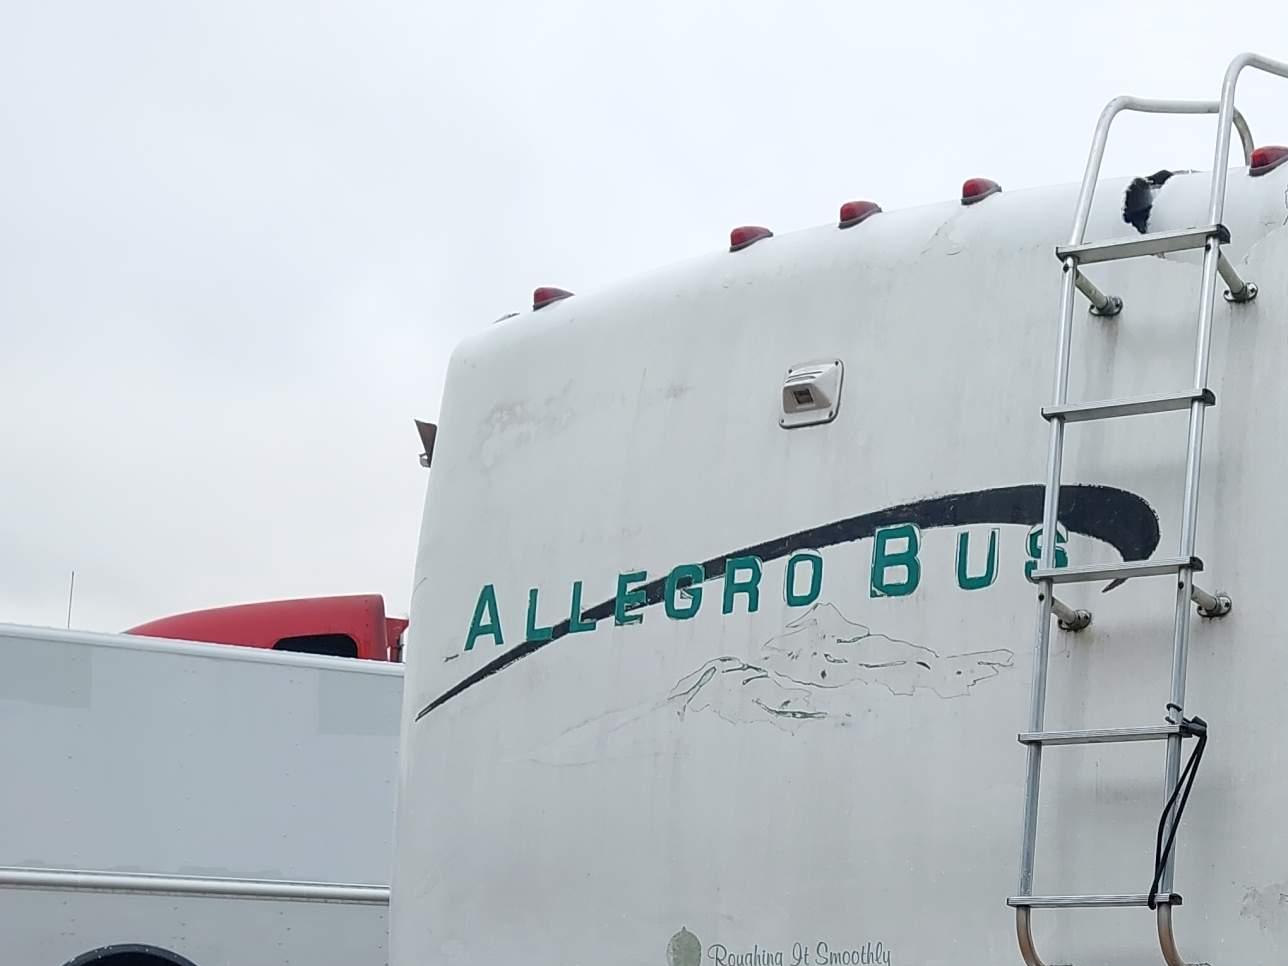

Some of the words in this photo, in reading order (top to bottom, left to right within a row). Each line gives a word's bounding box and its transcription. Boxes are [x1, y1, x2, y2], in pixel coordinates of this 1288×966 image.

[464, 548, 825, 652] ALLEGRO
[869, 521, 1069, 599] BUS
[790, 942, 810, 966] It
